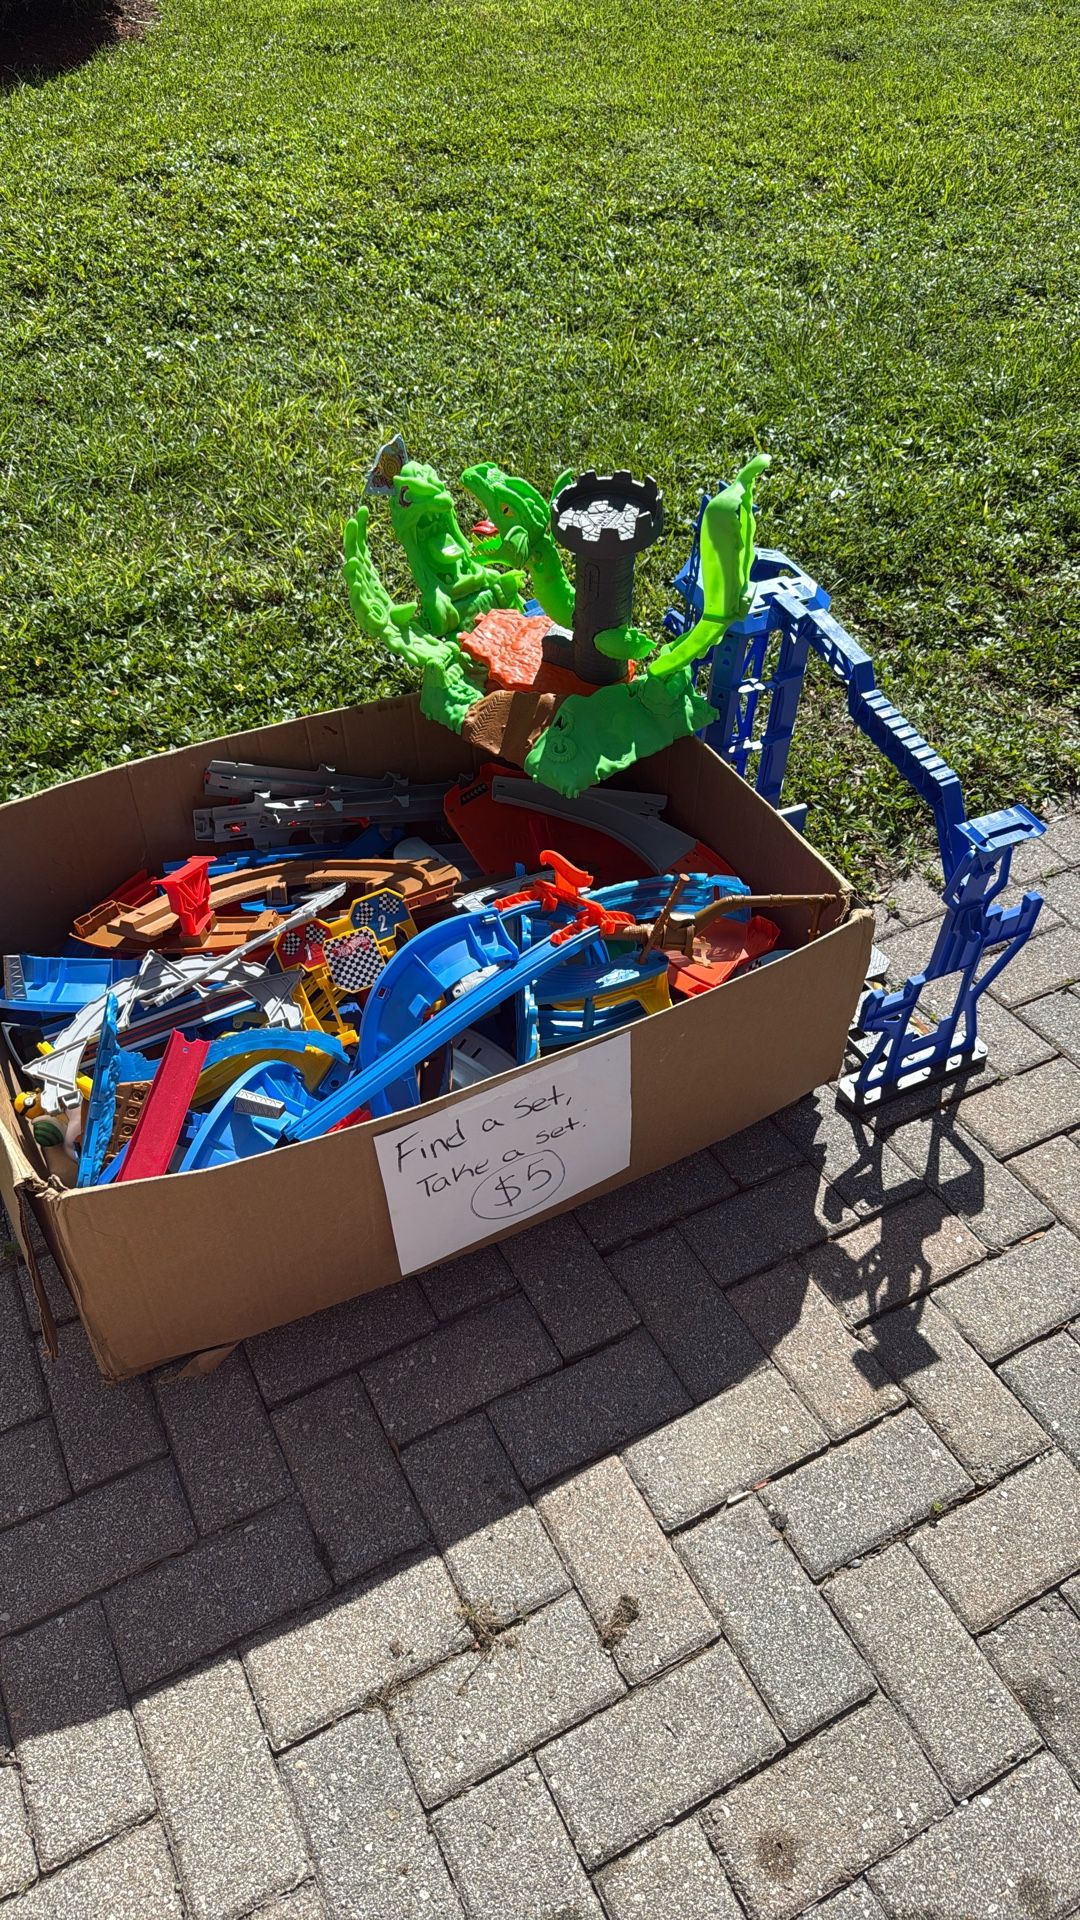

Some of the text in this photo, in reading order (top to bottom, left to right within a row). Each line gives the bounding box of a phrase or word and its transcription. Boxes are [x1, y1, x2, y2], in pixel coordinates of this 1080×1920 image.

[378, 915, 388, 932] 2
[395, 1119, 467, 1173] Find
[482, 1118, 504, 1132] a
[416, 1117, 586, 1198] Take a set.
[494, 1158, 552, 1207] $5
